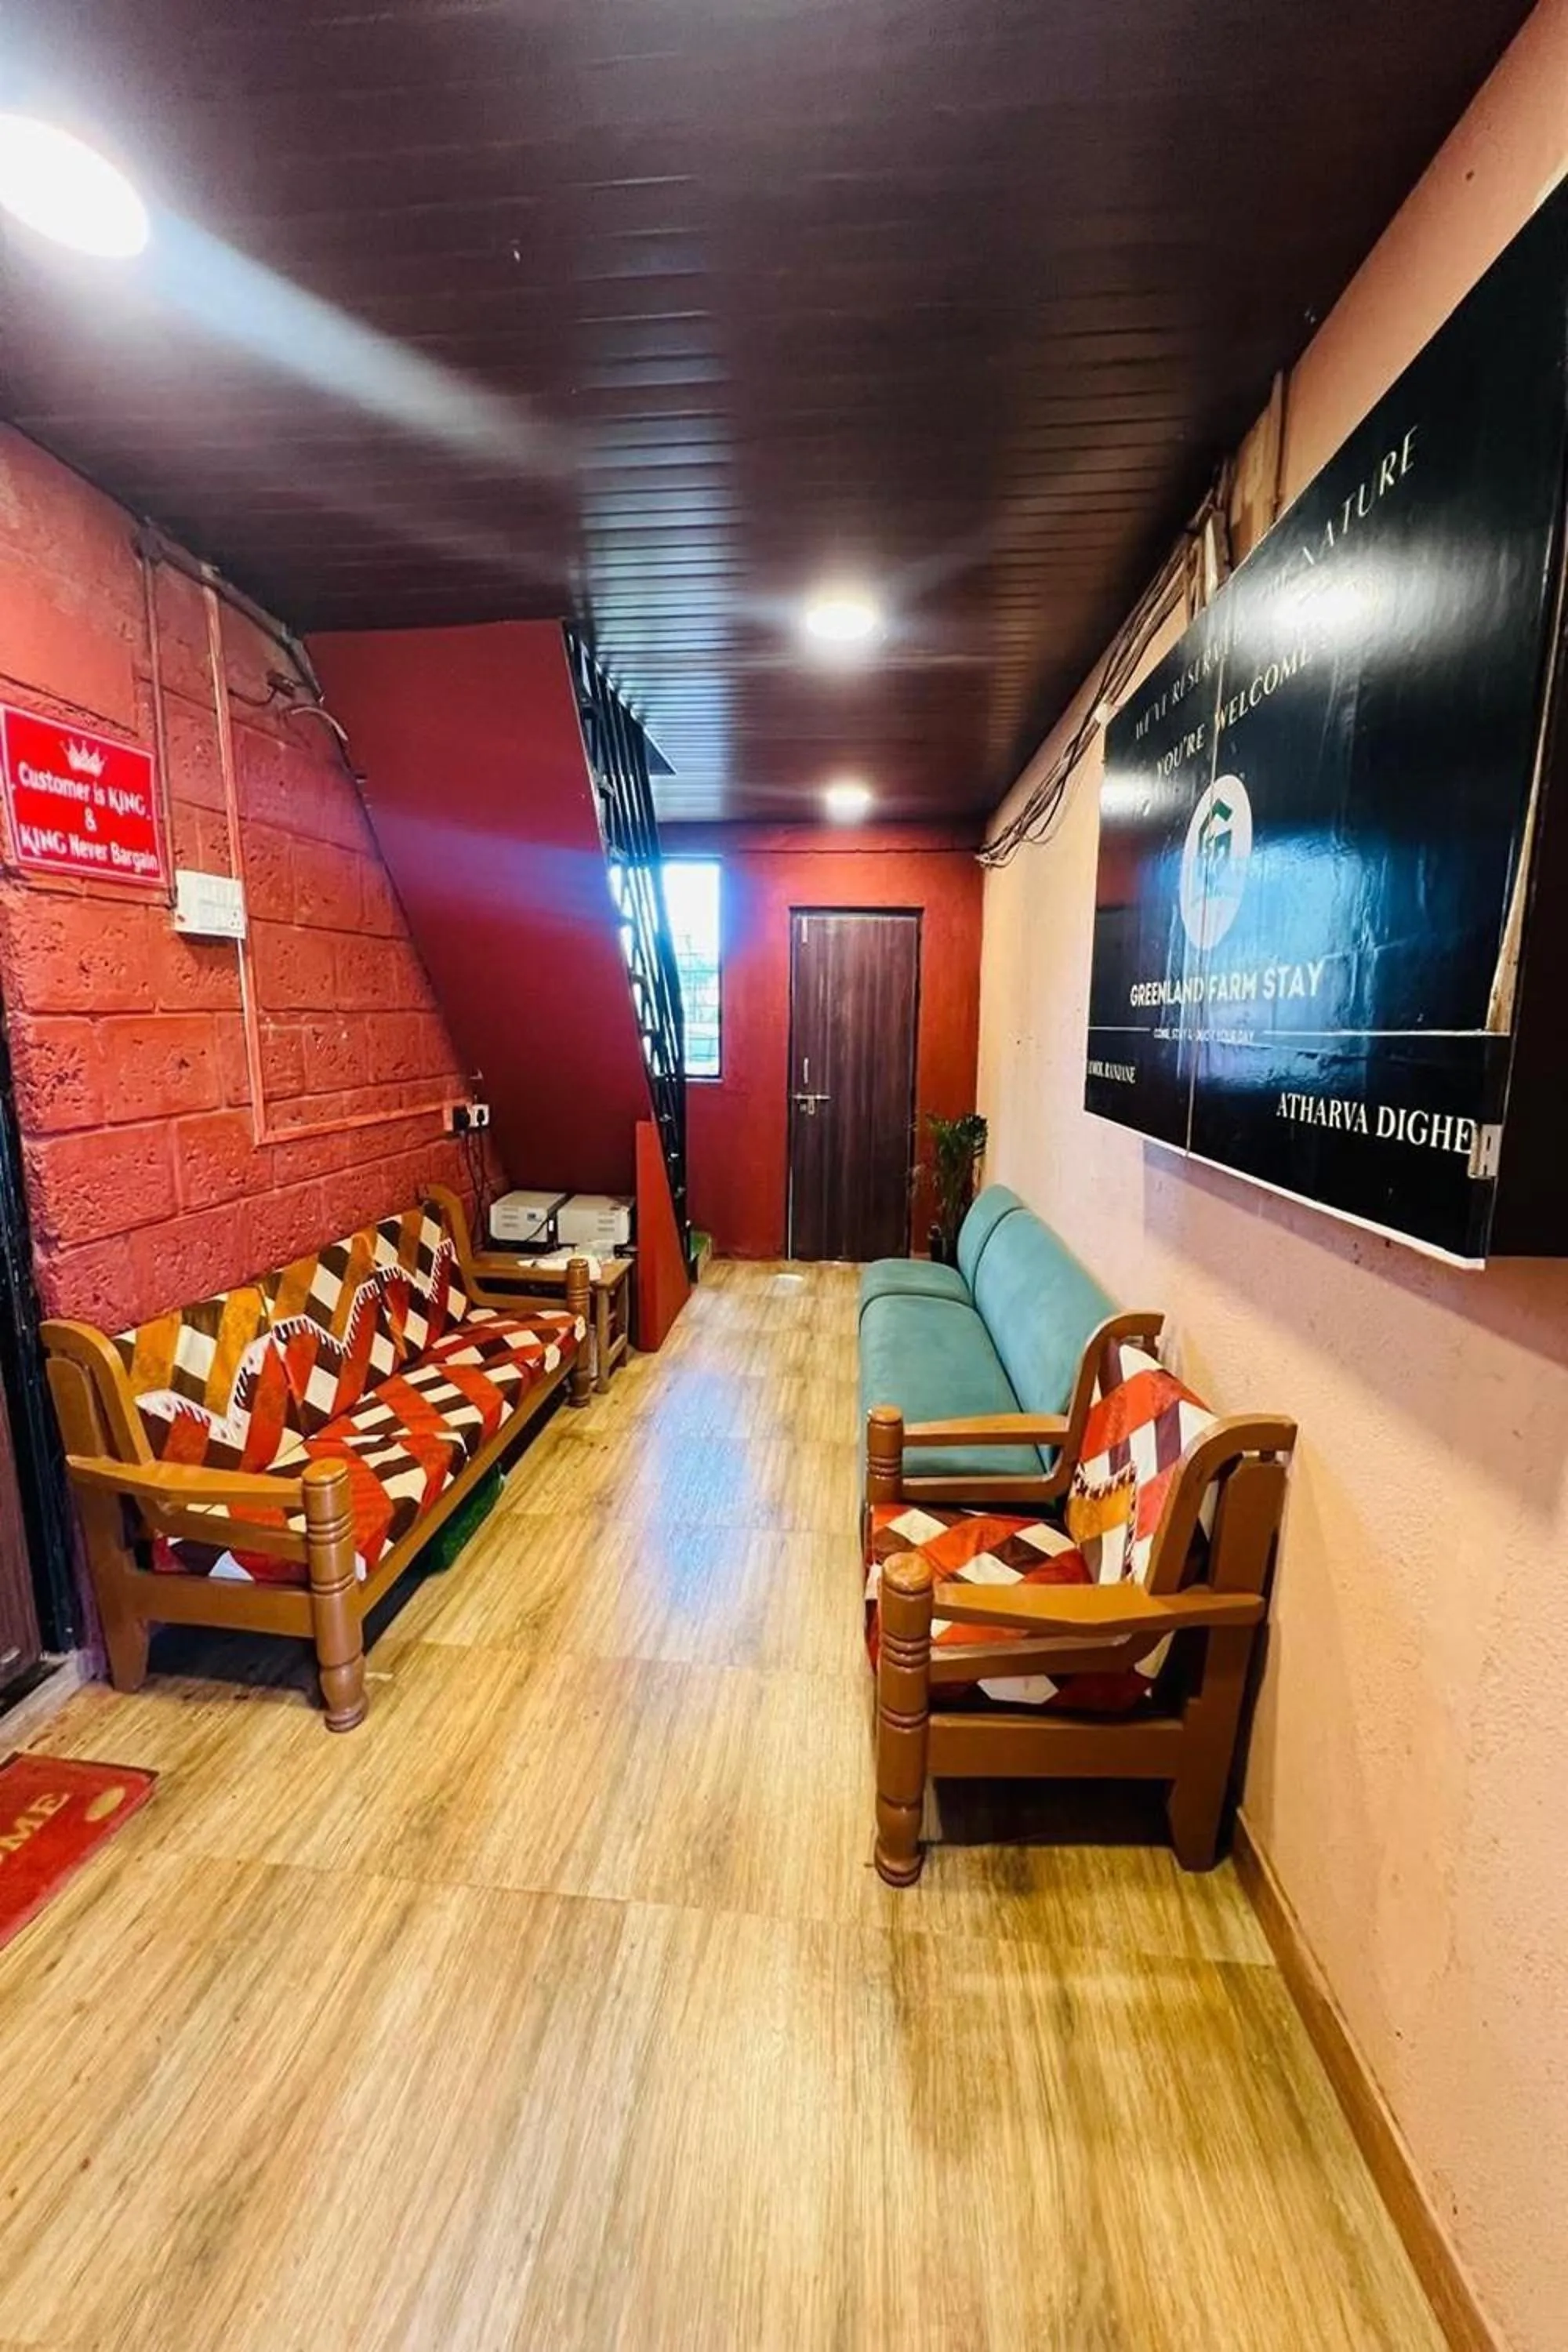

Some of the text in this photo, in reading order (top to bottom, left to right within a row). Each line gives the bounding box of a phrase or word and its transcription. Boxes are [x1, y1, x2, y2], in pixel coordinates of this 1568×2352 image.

[1156, 638, 1313, 781] YOU'RE WELCOME
[18, 760, 147, 816] Customer is KING
[19, 822, 159, 873] KING Never Bargain
[84, 806, 97, 833] &
[1130, 962, 1327, 1007] GREENLAND FARM STAY
[1276, 1091, 1477, 1155] ATHARVA DIGHE
[0, 1793, 71, 1863] ME
